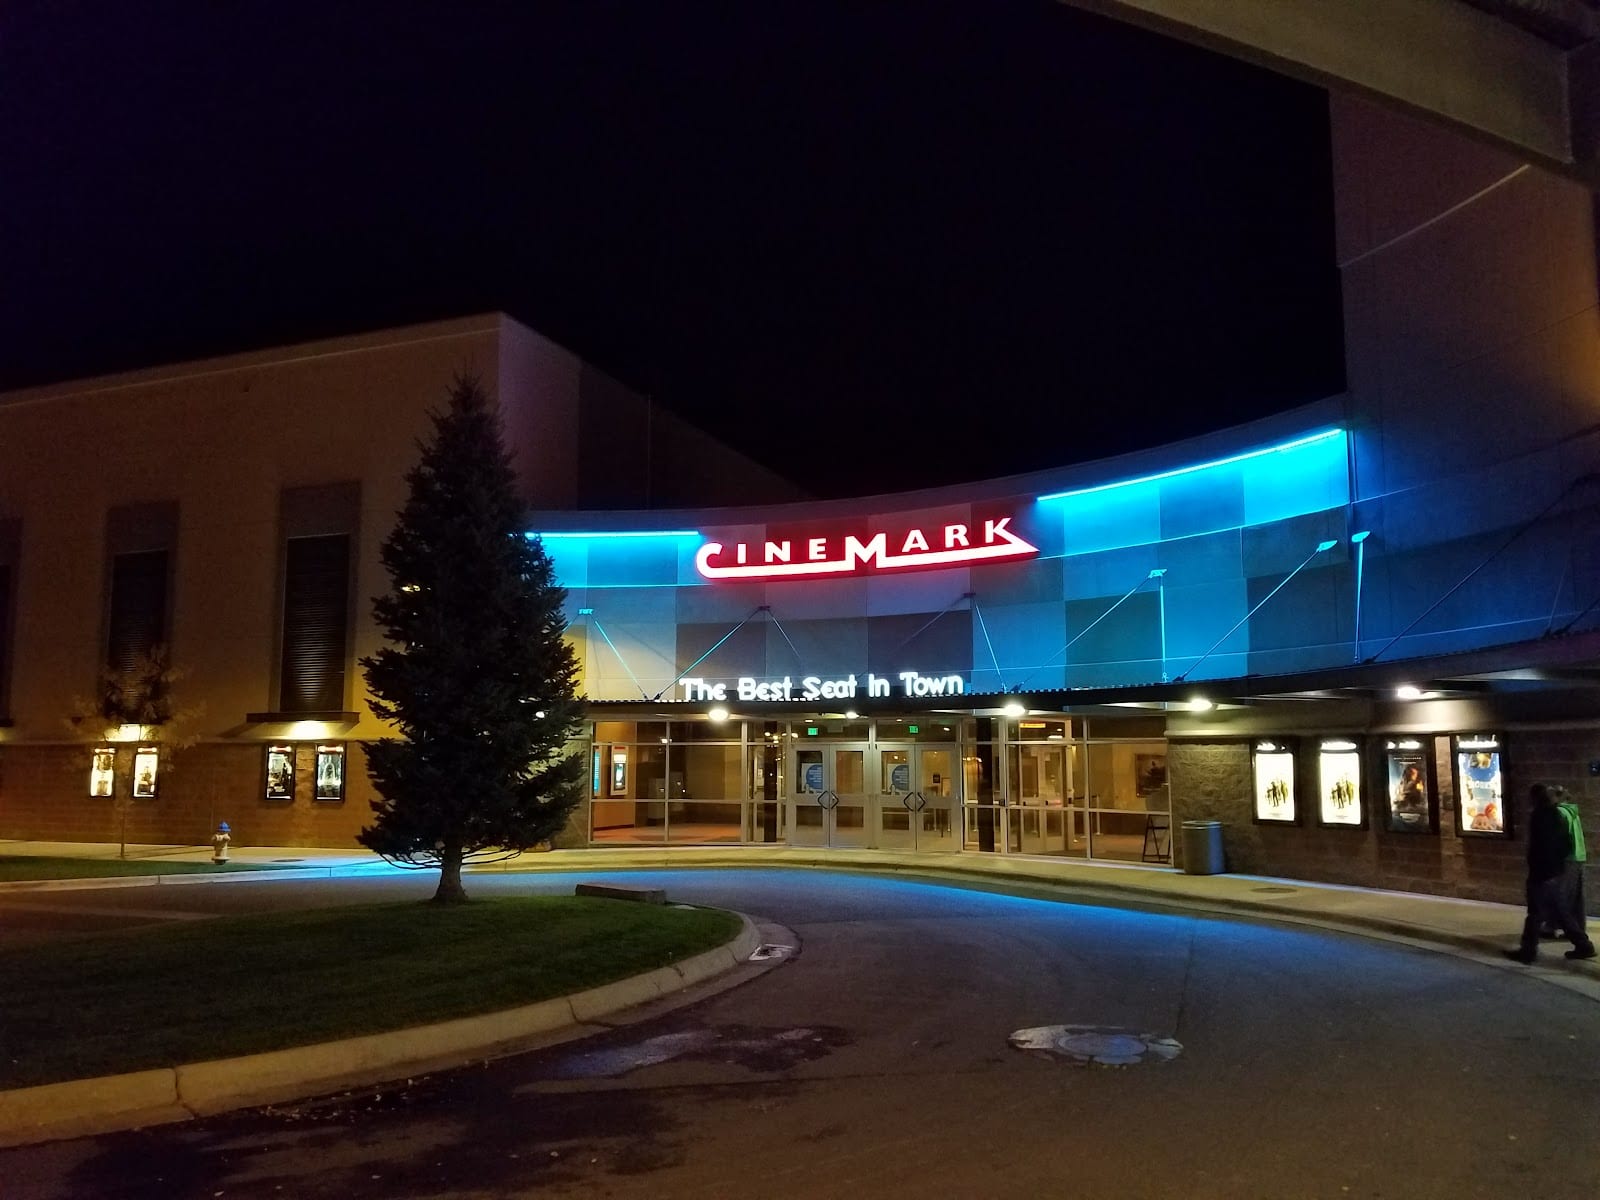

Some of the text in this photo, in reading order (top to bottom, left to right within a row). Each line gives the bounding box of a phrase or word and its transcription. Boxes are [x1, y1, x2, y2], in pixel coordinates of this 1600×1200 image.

[696, 517, 1039, 578] CINEMARK
[679, 671, 963, 700] The Best Seat In Town
